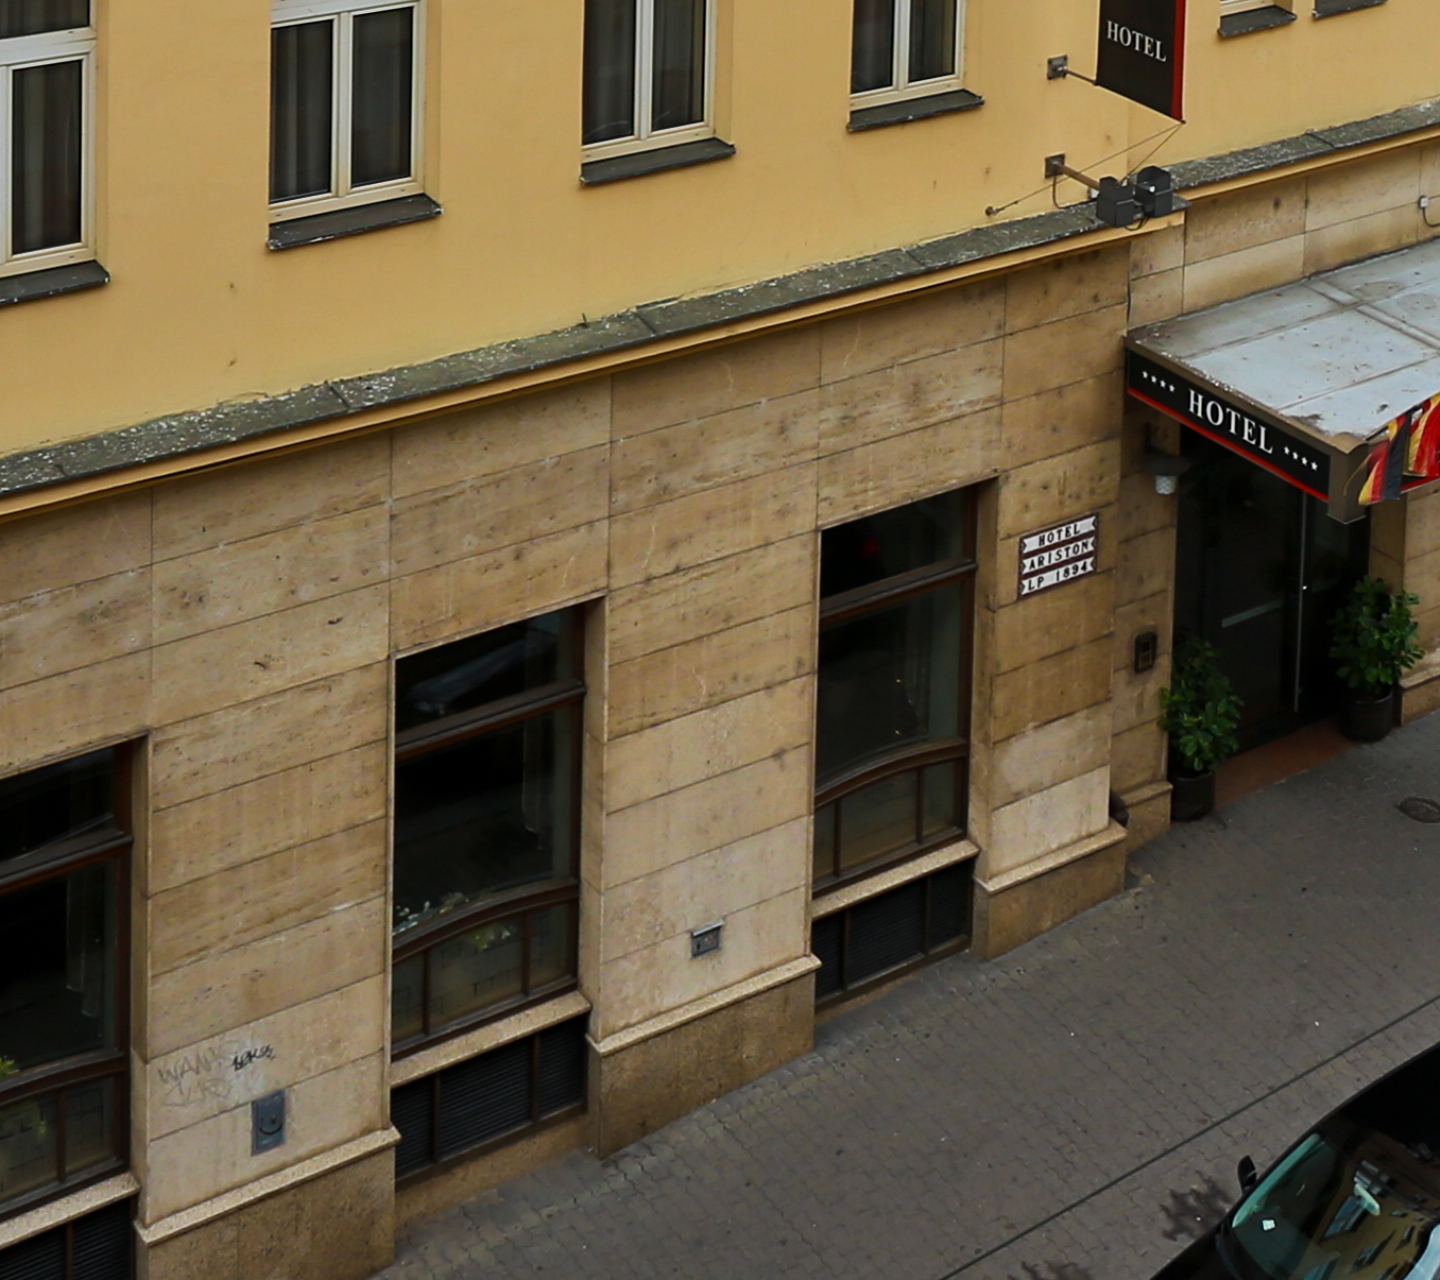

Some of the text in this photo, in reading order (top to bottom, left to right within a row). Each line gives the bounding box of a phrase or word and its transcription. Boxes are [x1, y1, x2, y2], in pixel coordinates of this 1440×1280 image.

[1106, 19, 1169, 64] HOTEL
[1188, 388, 1274, 455] HOTEL
[1038, 523, 1081, 547] HOTEL
[1028, 539, 1089, 571] ARISTON
[1027, 561, 1088, 591] LP 1894
